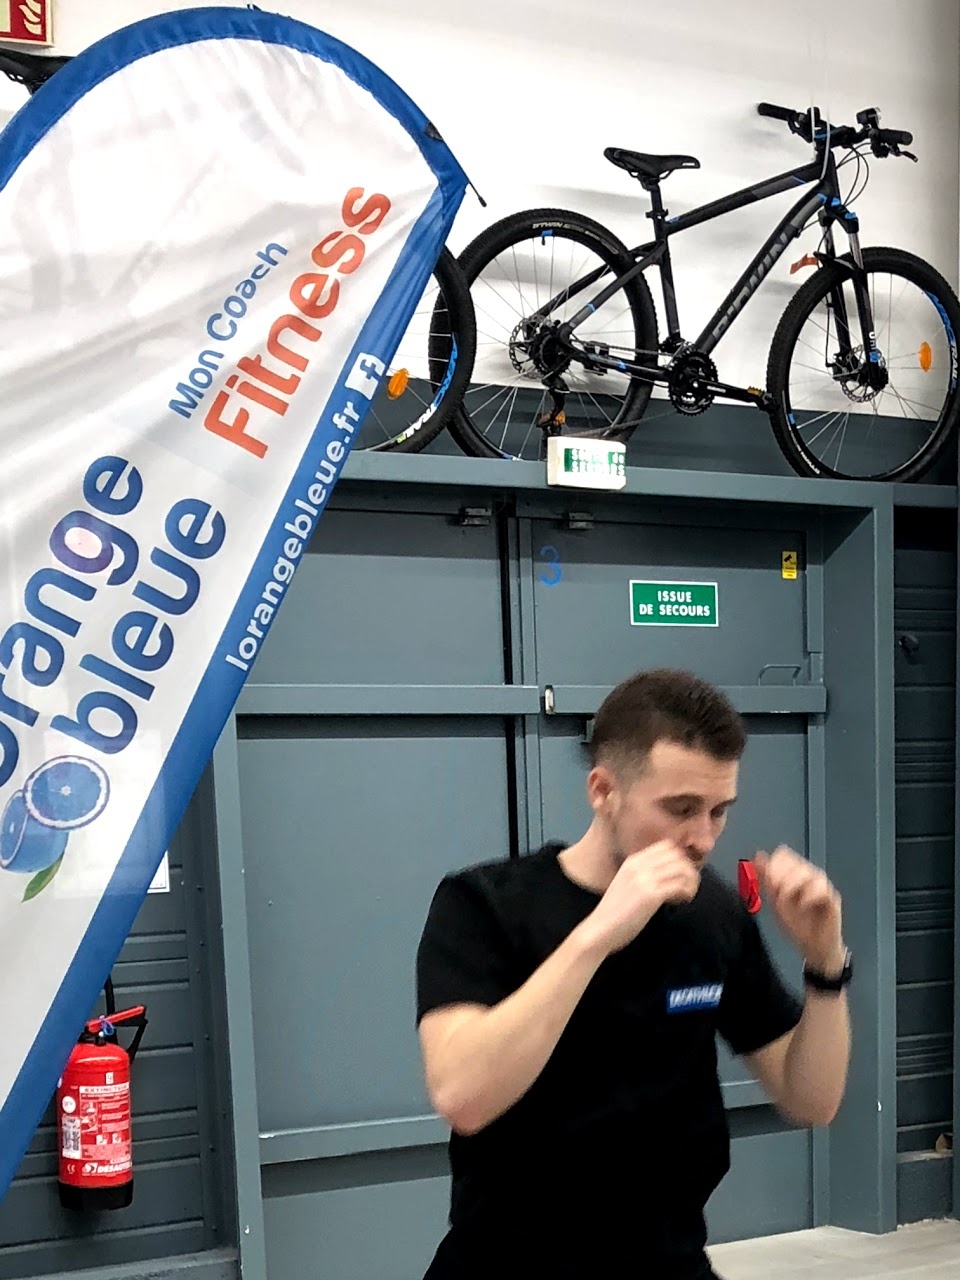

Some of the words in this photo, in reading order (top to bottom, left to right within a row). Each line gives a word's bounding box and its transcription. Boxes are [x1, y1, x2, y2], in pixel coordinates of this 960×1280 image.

[168, 350, 225, 419] Mon
[206, 242, 288, 341] Coach
[203, 187, 392, 459] Fitness
[225, 401, 360, 671] lorangebleue.fr
[540, 545, 562, 587] 3
[639, 603, 653, 616] DE
[659, 604, 710, 617] SECOURS
[657, 590, 692, 603] ISSUE
[50, 498, 226, 754] bleue
